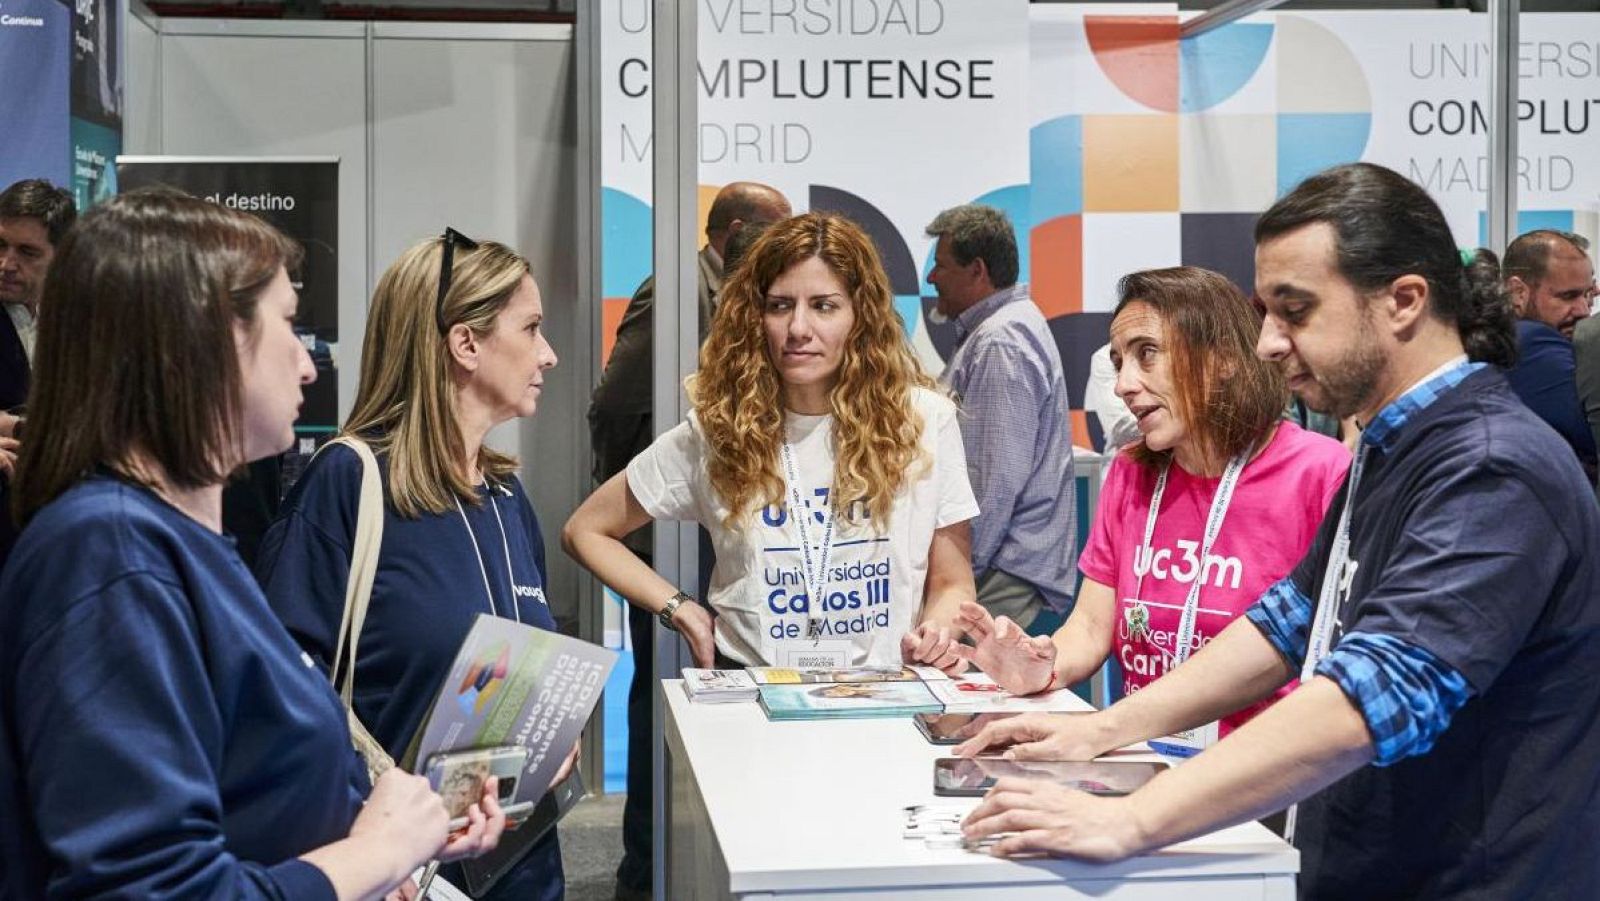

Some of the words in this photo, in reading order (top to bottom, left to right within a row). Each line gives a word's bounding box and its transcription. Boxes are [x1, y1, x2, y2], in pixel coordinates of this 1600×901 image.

[619, 0, 945, 35] UVERSIDAD
[619, 58, 995, 99] CMPLUTENSE
[1410, 42, 1600, 79] UNIERSI
[620, 123, 813, 163] MDRID
[225, 193, 295, 211] destino
[764, 557, 890, 586] Univrsidad
[1133, 539, 1243, 588] uc3m
[767, 588, 862, 615] Calos
[865, 578, 890, 607] III
[769, 618, 801, 640] de
[1121, 643, 1177, 677] Carl
[531, 656, 579, 743] alineado
[568, 663, 604, 720] ICDL:
[528, 660, 592, 775] totalmente
